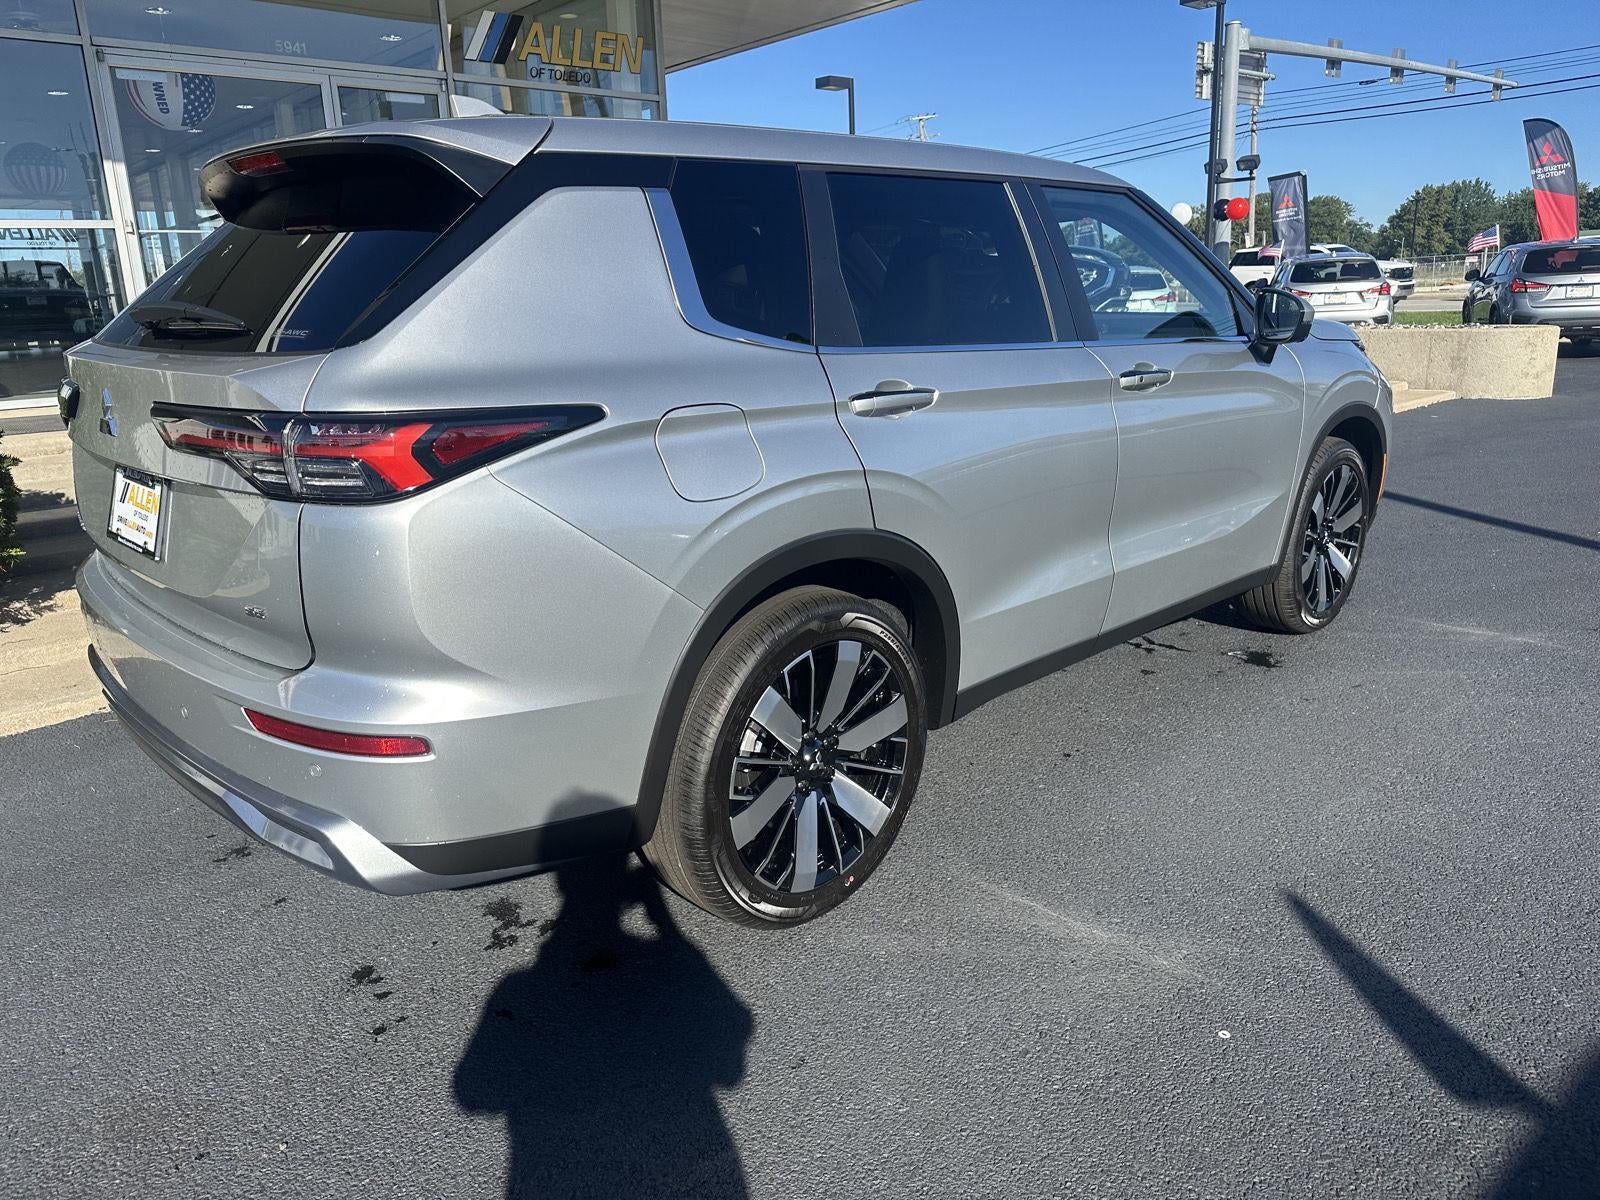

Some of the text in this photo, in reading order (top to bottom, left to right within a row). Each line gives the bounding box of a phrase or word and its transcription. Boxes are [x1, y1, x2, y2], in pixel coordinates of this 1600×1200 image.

[275, 40, 307, 55] 5941
[518, 22, 644, 73] ALLEN
[530, 67, 591, 83] OF TOLEDO
[152, 80, 170, 114] WNED
[127, 485, 160, 515] ALLEN
